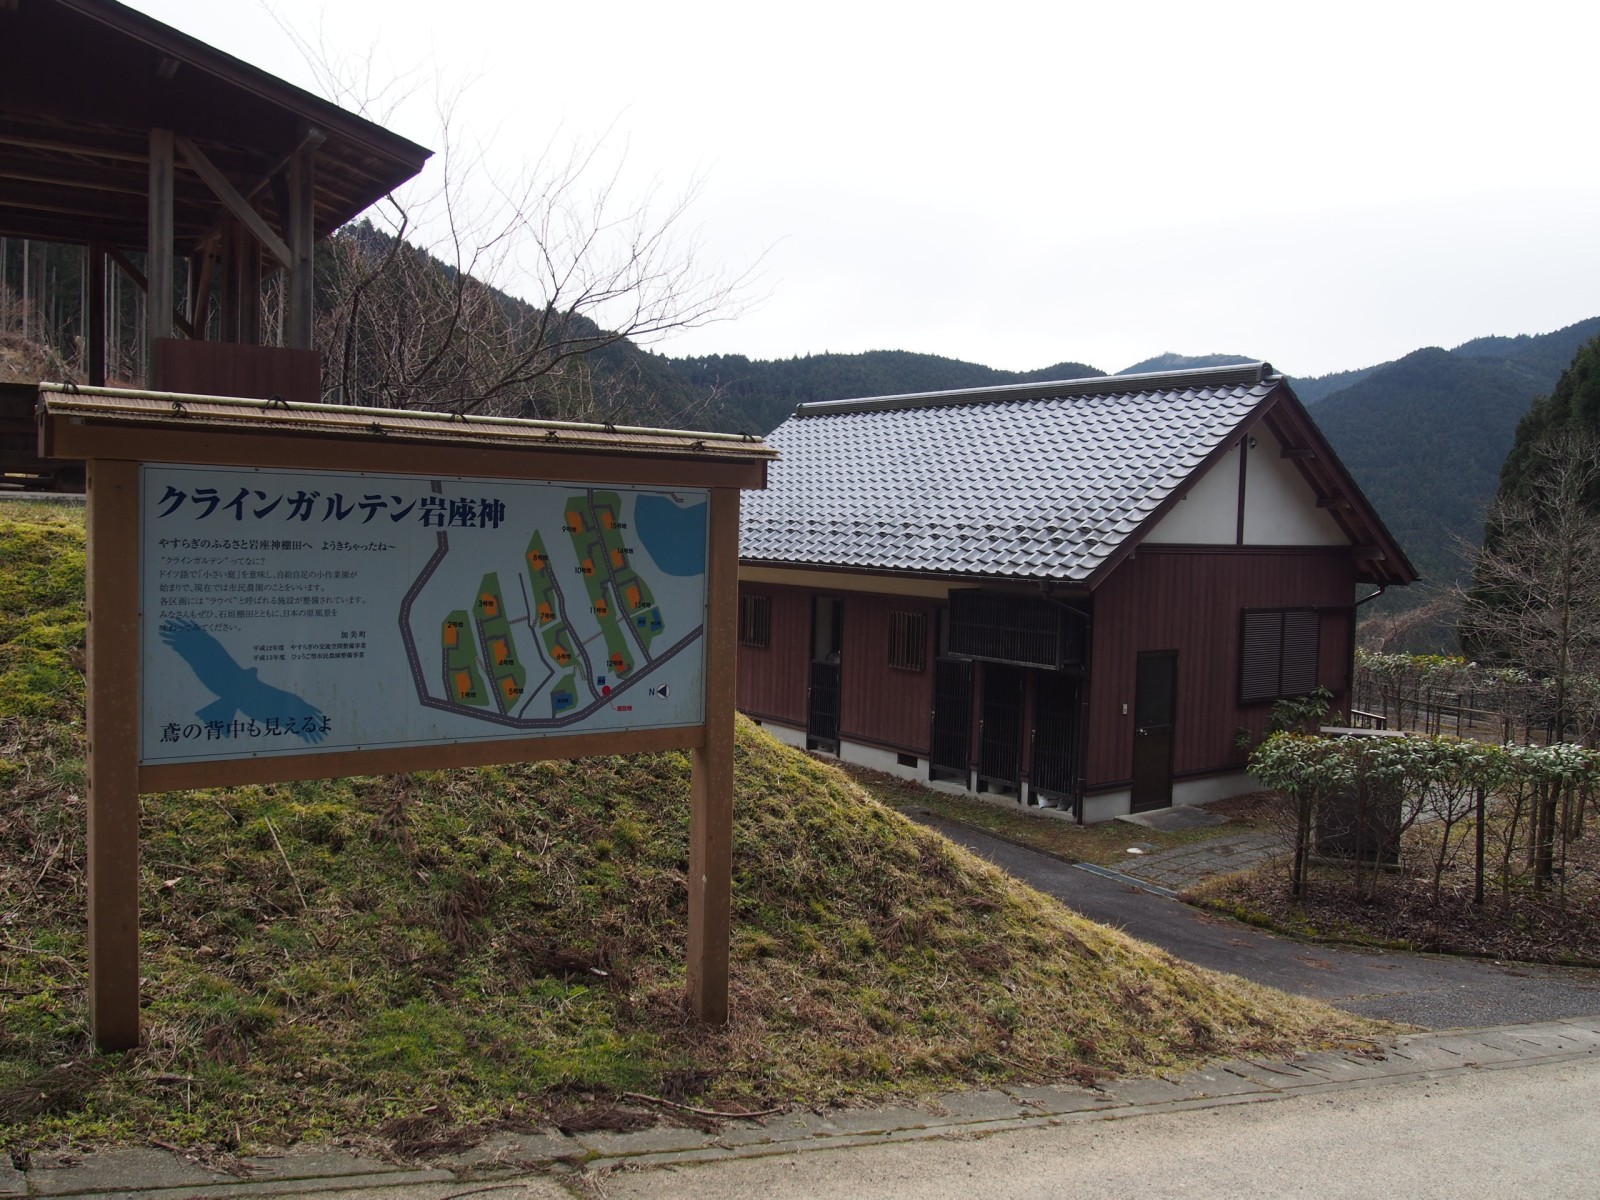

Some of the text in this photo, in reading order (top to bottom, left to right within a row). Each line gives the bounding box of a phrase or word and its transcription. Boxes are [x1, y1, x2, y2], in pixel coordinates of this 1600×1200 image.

[157, 486, 505, 529] クラインガルテン岩座神
[158, 538, 313, 552] やすらぎのふるさと岩座神棚田へ
[648, 688, 655, 696] N
[160, 715, 332, 743] 鳶の背中も見えるよ
